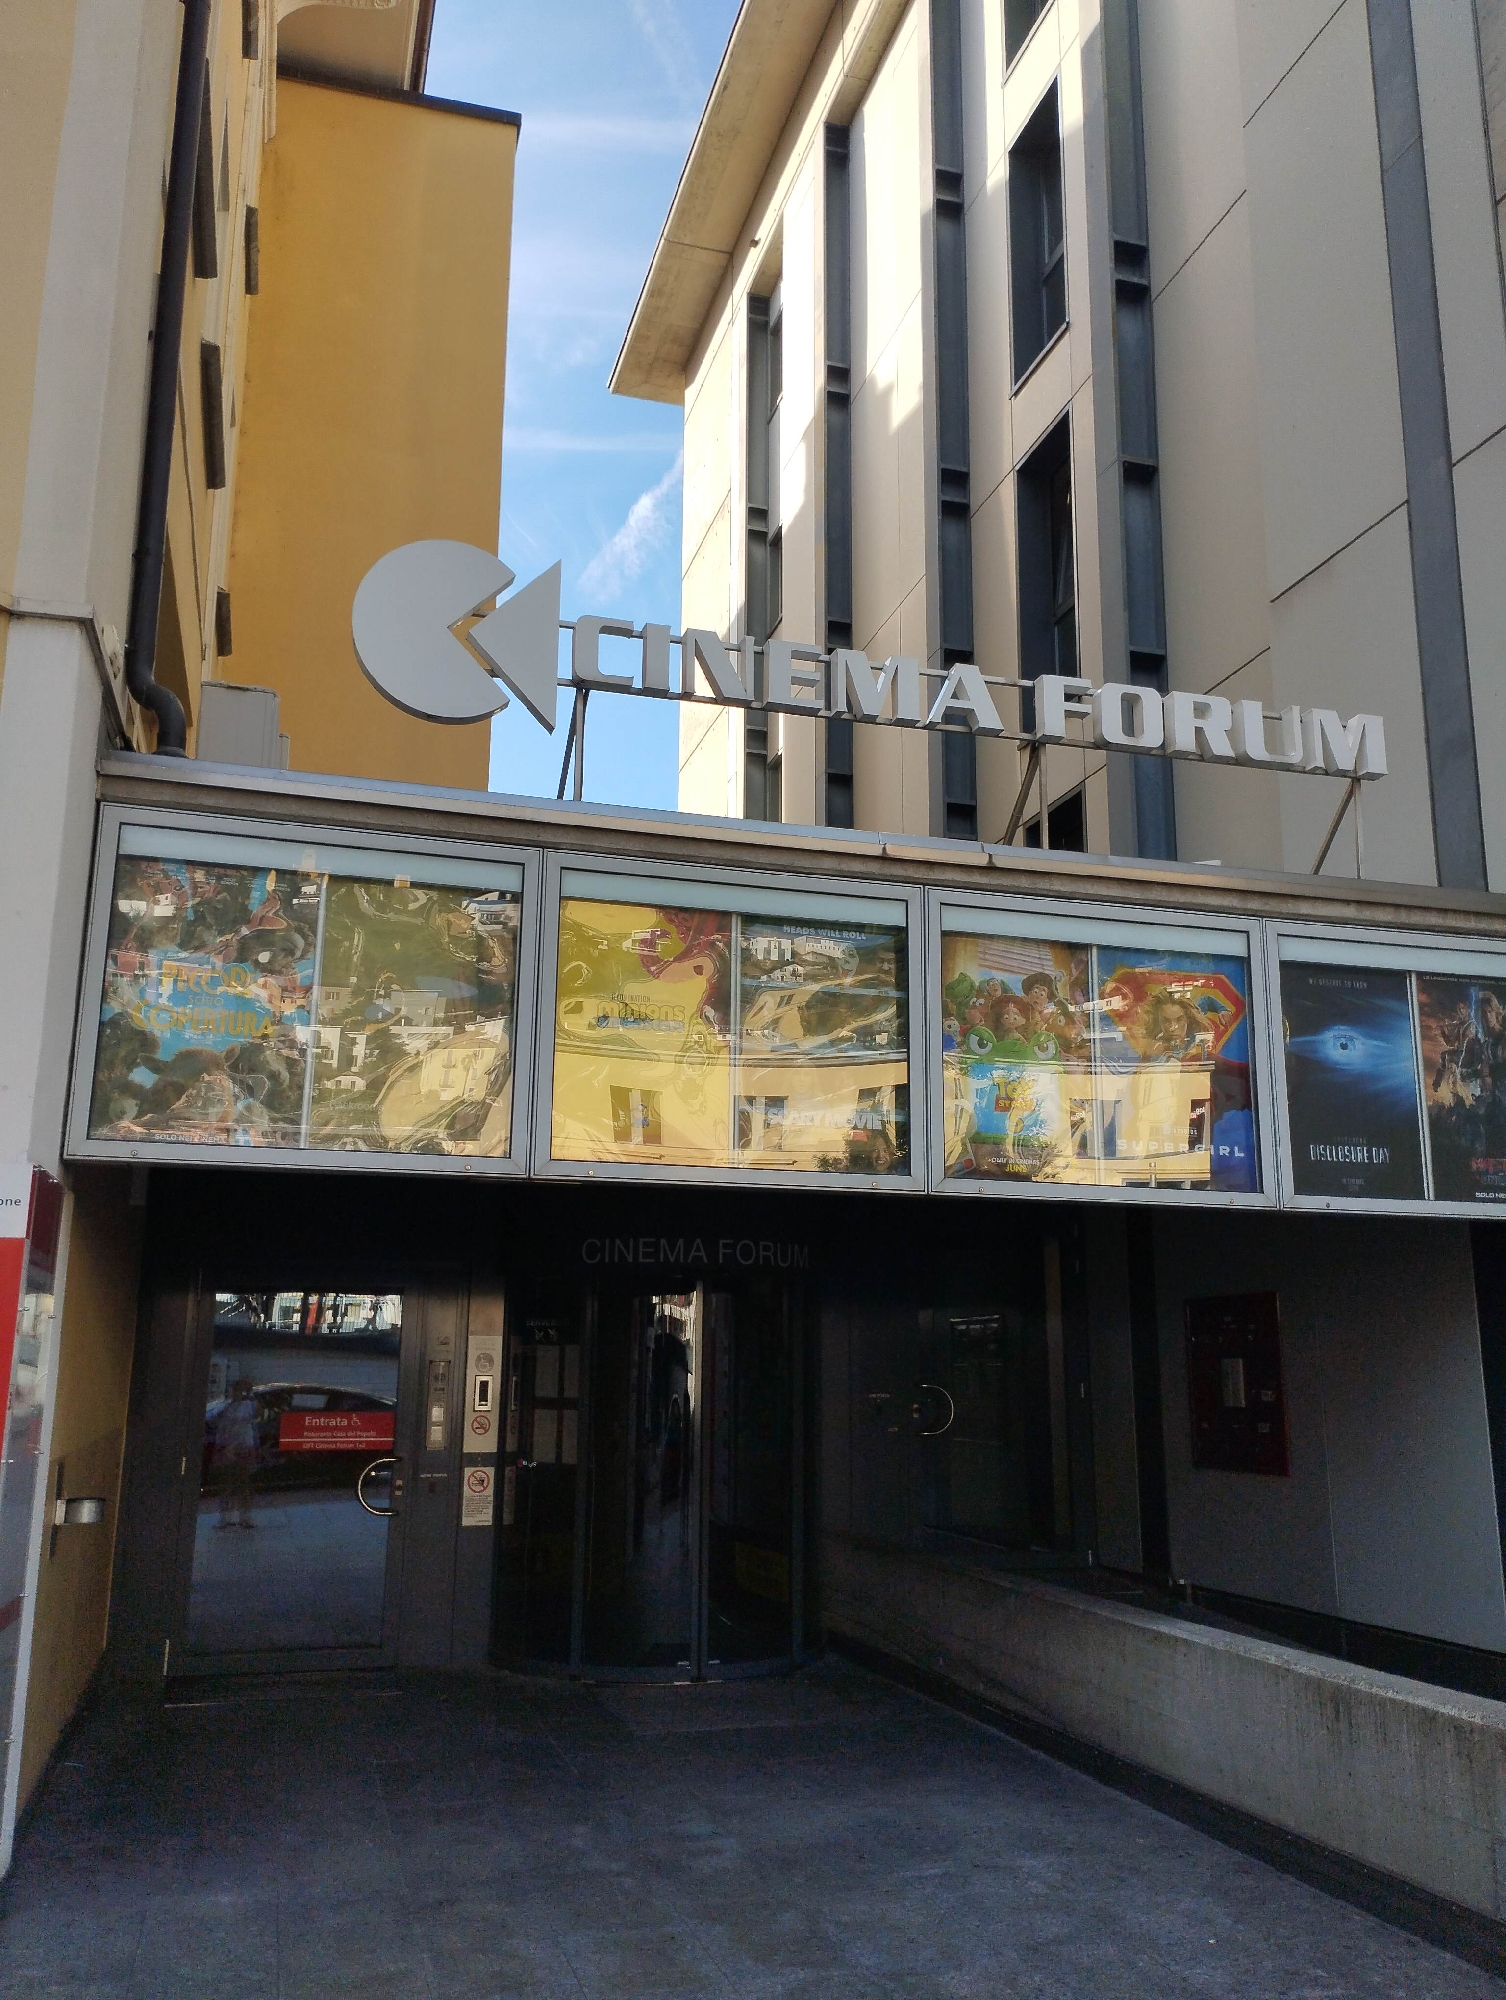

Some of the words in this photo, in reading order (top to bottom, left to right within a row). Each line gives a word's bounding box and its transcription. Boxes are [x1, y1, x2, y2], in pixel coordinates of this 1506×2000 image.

[573, 614, 1004, 737] CINEMA
[1034, 674, 1388, 781] FORUM
[783, 924, 815, 935] HEADS
[818, 928, 841, 938] WILL
[842, 930, 867, 940] ROLL
[162, 961, 255, 998] PECOR
[132, 999, 275, 1038] COPERTURA
[993, 1077, 1035, 1099] TOY
[154, 1133, 177, 1141] SOLO
[1117, 1139, 1245, 1157] SUPERGIRL
[1309, 1144, 1370, 1163] DISCLOSURE
[1372, 1147, 1391, 1164] DAY
[581, 1238, 709, 1264] CINEMA
[718, 1239, 809, 1269] FORUM
[305, 1416, 348, 1426] Entrata
